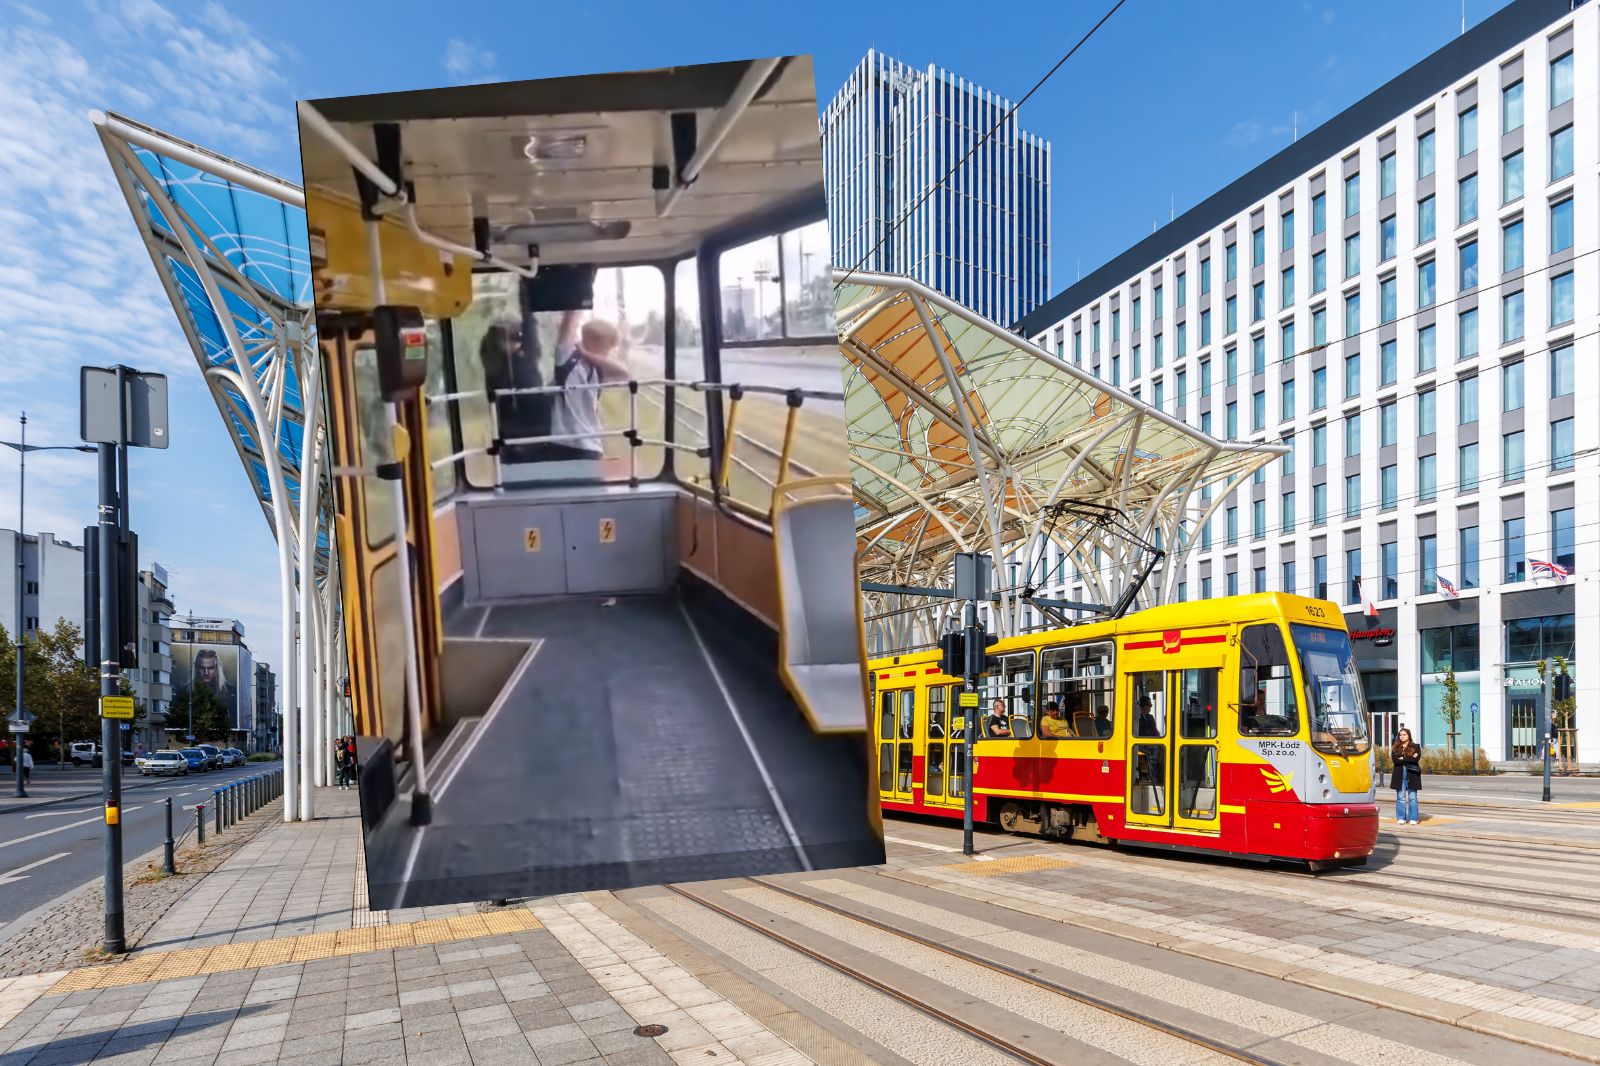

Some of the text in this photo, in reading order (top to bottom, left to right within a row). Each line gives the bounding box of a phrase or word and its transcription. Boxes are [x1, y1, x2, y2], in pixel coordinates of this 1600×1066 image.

[1305, 606, 1325, 617] 1623
[1350, 628, 1395, 640] Hampton
[1258, 741, 1300, 749] MPK-Łódź
[1262, 749, 1275, 757] Sp.
